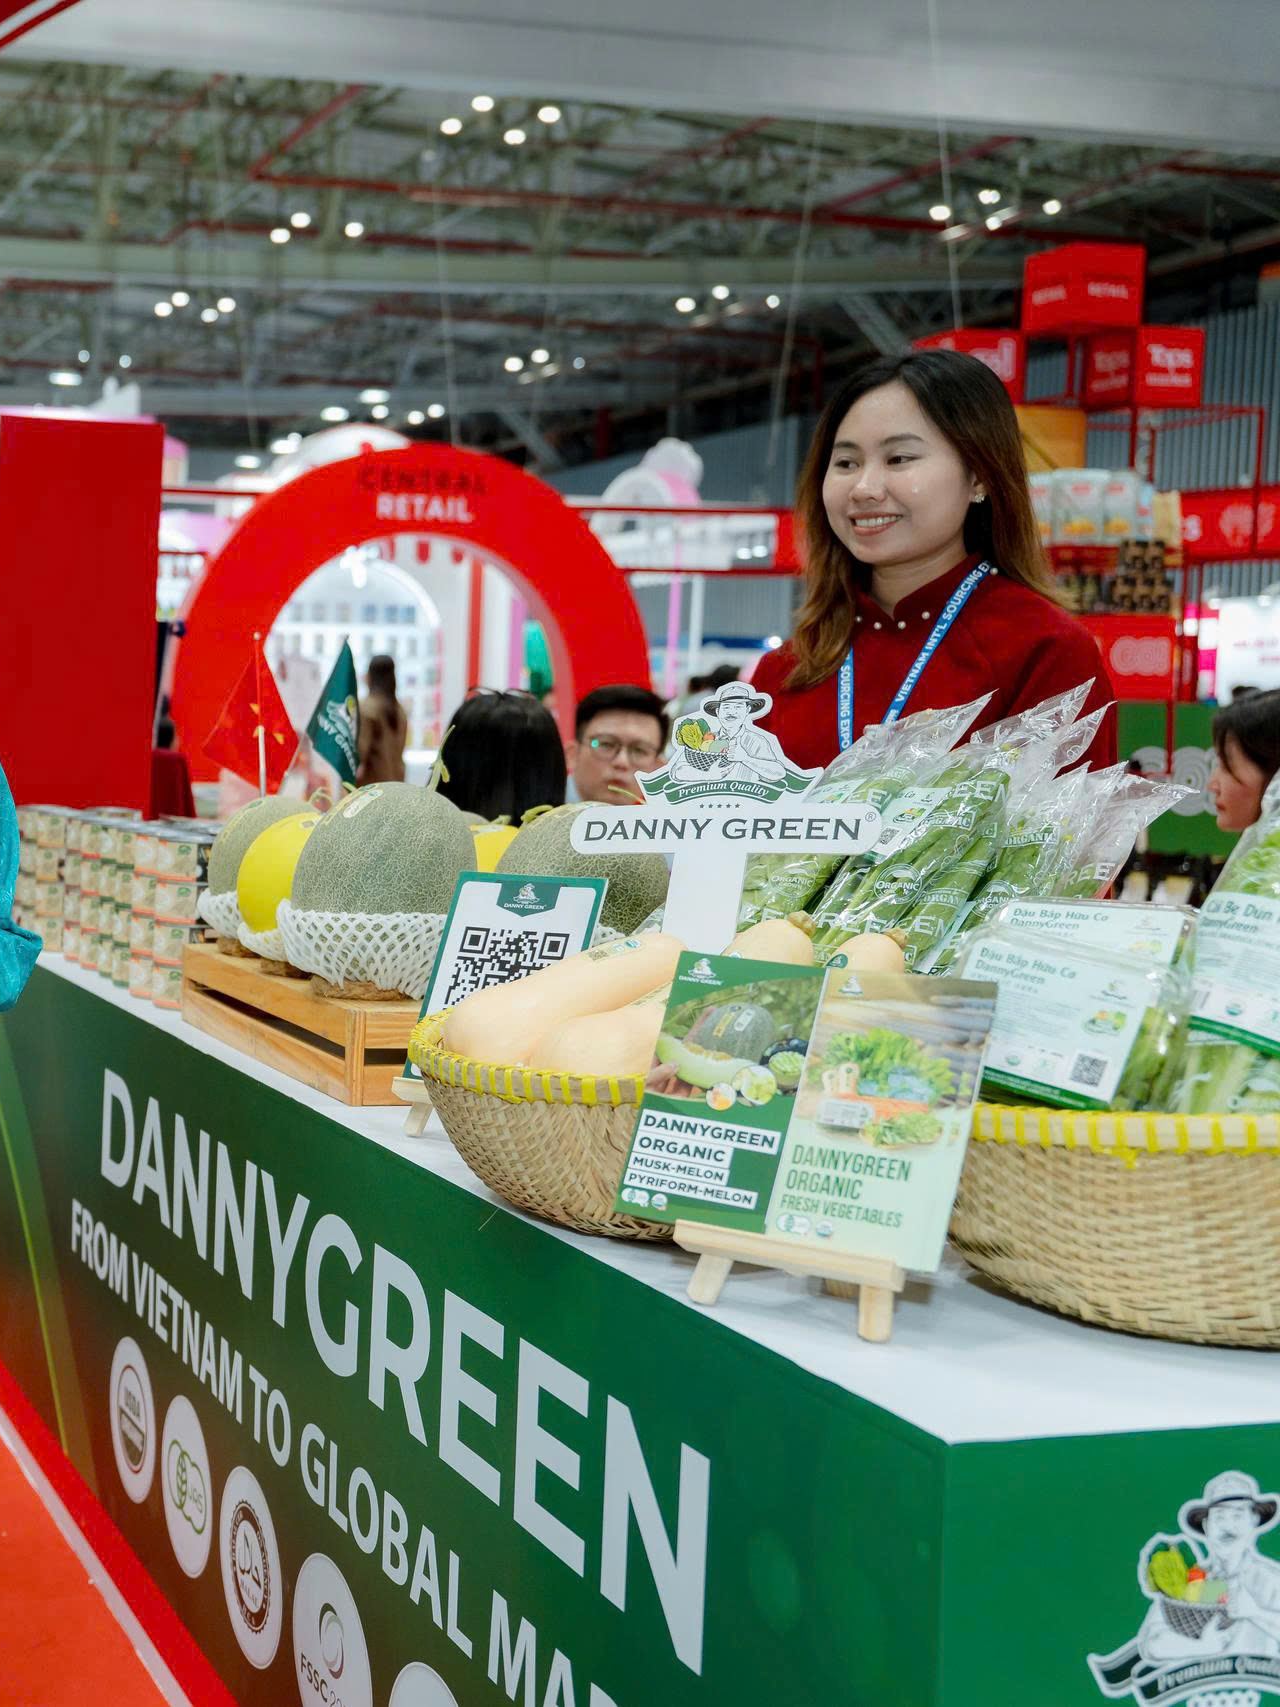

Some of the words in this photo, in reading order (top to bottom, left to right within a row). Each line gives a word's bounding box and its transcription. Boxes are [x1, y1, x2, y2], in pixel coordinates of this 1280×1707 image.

[376, 493, 474, 523] RETAIL
[895, 652, 930, 702] VIETNAM
[926, 623, 948, 651] INT'L
[942, 570, 983, 620] SOURCING
[840, 665, 851, 717] SOURCING
[840, 719, 850, 749] EXPO
[678, 782, 727, 797] Premium
[729, 781, 770, 797] Quality
[583, 818, 713, 841] DANNY
[722, 818, 862, 841] GREEN
[876, 880, 920, 891] ORGANIC
[1010, 917, 1080, 929] DannyGreen
[975, 960, 1046, 985] DannyGreen
[643, 1114, 776, 1148] DANNYGREEN
[638, 1137, 726, 1163] ORGANIC
[792, 1144, 912, 1182] DANNYGREEN
[632, 1156, 725, 1182] MUSK-MELON
[786, 1169, 863, 1200] ORGANIC
[628, 1173, 754, 1206] PYRIFORM-MELON
[780, 1193, 818, 1214] FRESH
[822, 1202, 903, 1228] VEGETABLES
[100, 1067, 711, 1677] DANNYGREEN
[72, 1198, 128, 1304] FROM
[132, 1251, 242, 1425] VIETNAM
[248, 1363, 291, 1468] TO
[300, 1422, 473, 1660] GLOBAL
[487, 1589, 618, 1707] MA
[301, 1652, 328, 1703] FSSC
[1158, 1656, 1233, 1692] Premium
